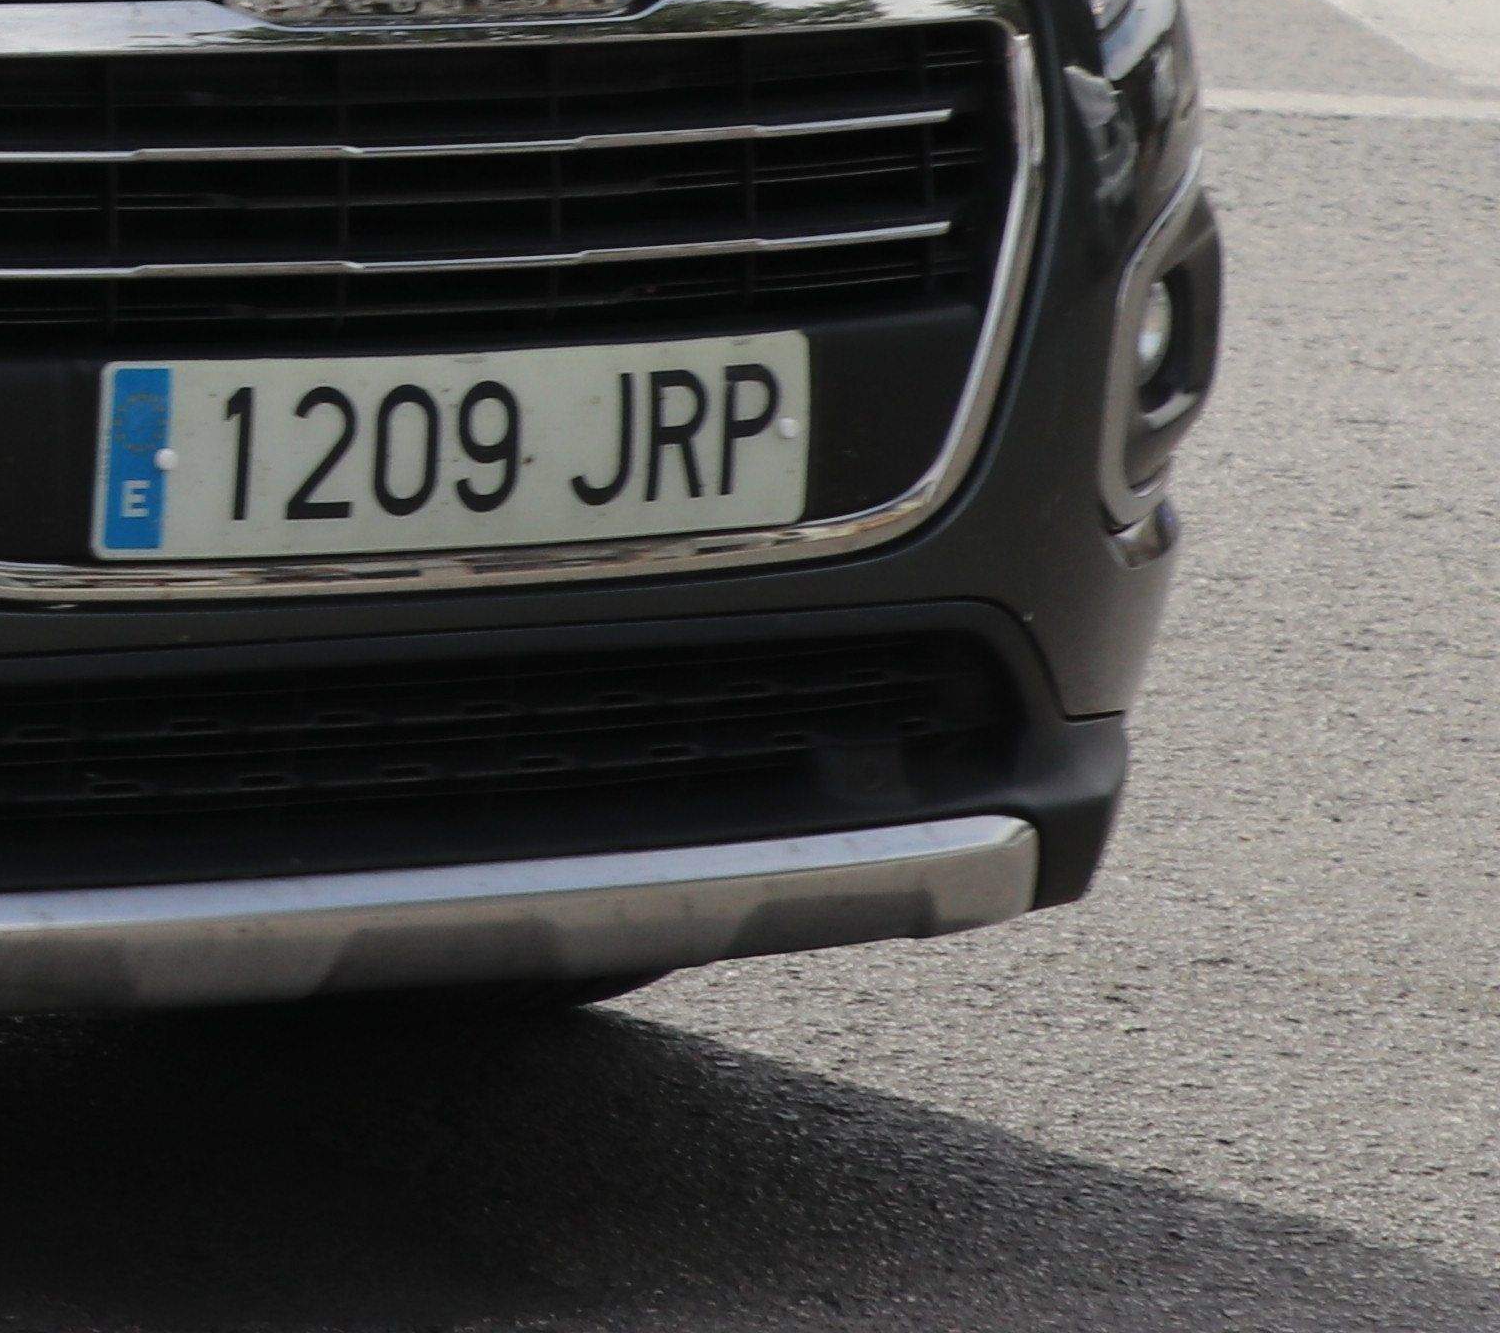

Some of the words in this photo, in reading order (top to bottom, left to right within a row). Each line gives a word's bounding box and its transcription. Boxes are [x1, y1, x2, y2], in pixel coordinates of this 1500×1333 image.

[222, 380, 522, 522] 1209
[570, 363, 782, 509] JRP
[120, 480, 150, 519] E
